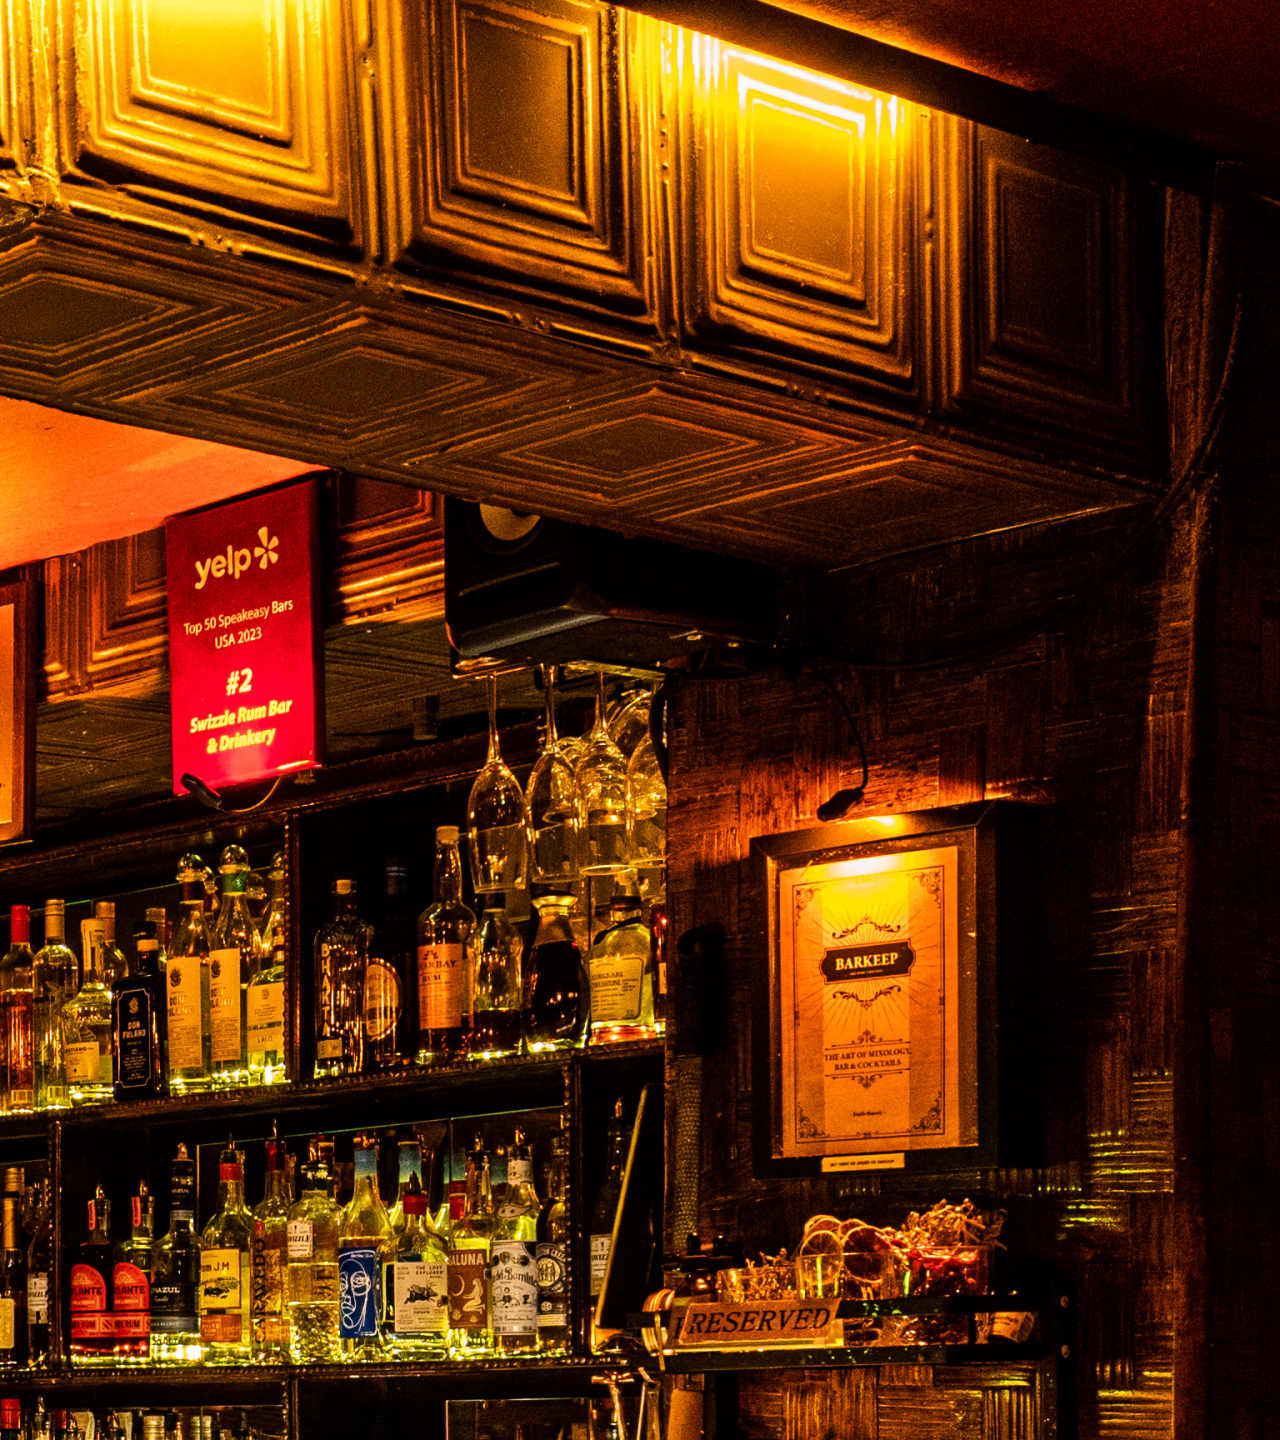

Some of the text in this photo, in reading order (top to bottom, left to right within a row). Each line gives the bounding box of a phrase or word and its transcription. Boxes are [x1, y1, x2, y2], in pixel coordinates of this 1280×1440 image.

[194, 545, 252, 590] yelp
[184, 599, 294, 637] Top 50 Speakeasy Bars
[214, 627, 263, 650] USA 2023
[226, 667, 253, 696] #2
[189, 699, 293, 734] Swizzle Rum Bar
[206, 727, 277, 755] & Drinkery
[835, 952, 899, 971] BARKEEP
[825, 1053, 839, 1061] THE
[840, 1052, 856, 1060] ART
[834, 1063, 850, 1071] BAR
[688, 1308, 830, 1335] RESERVED
